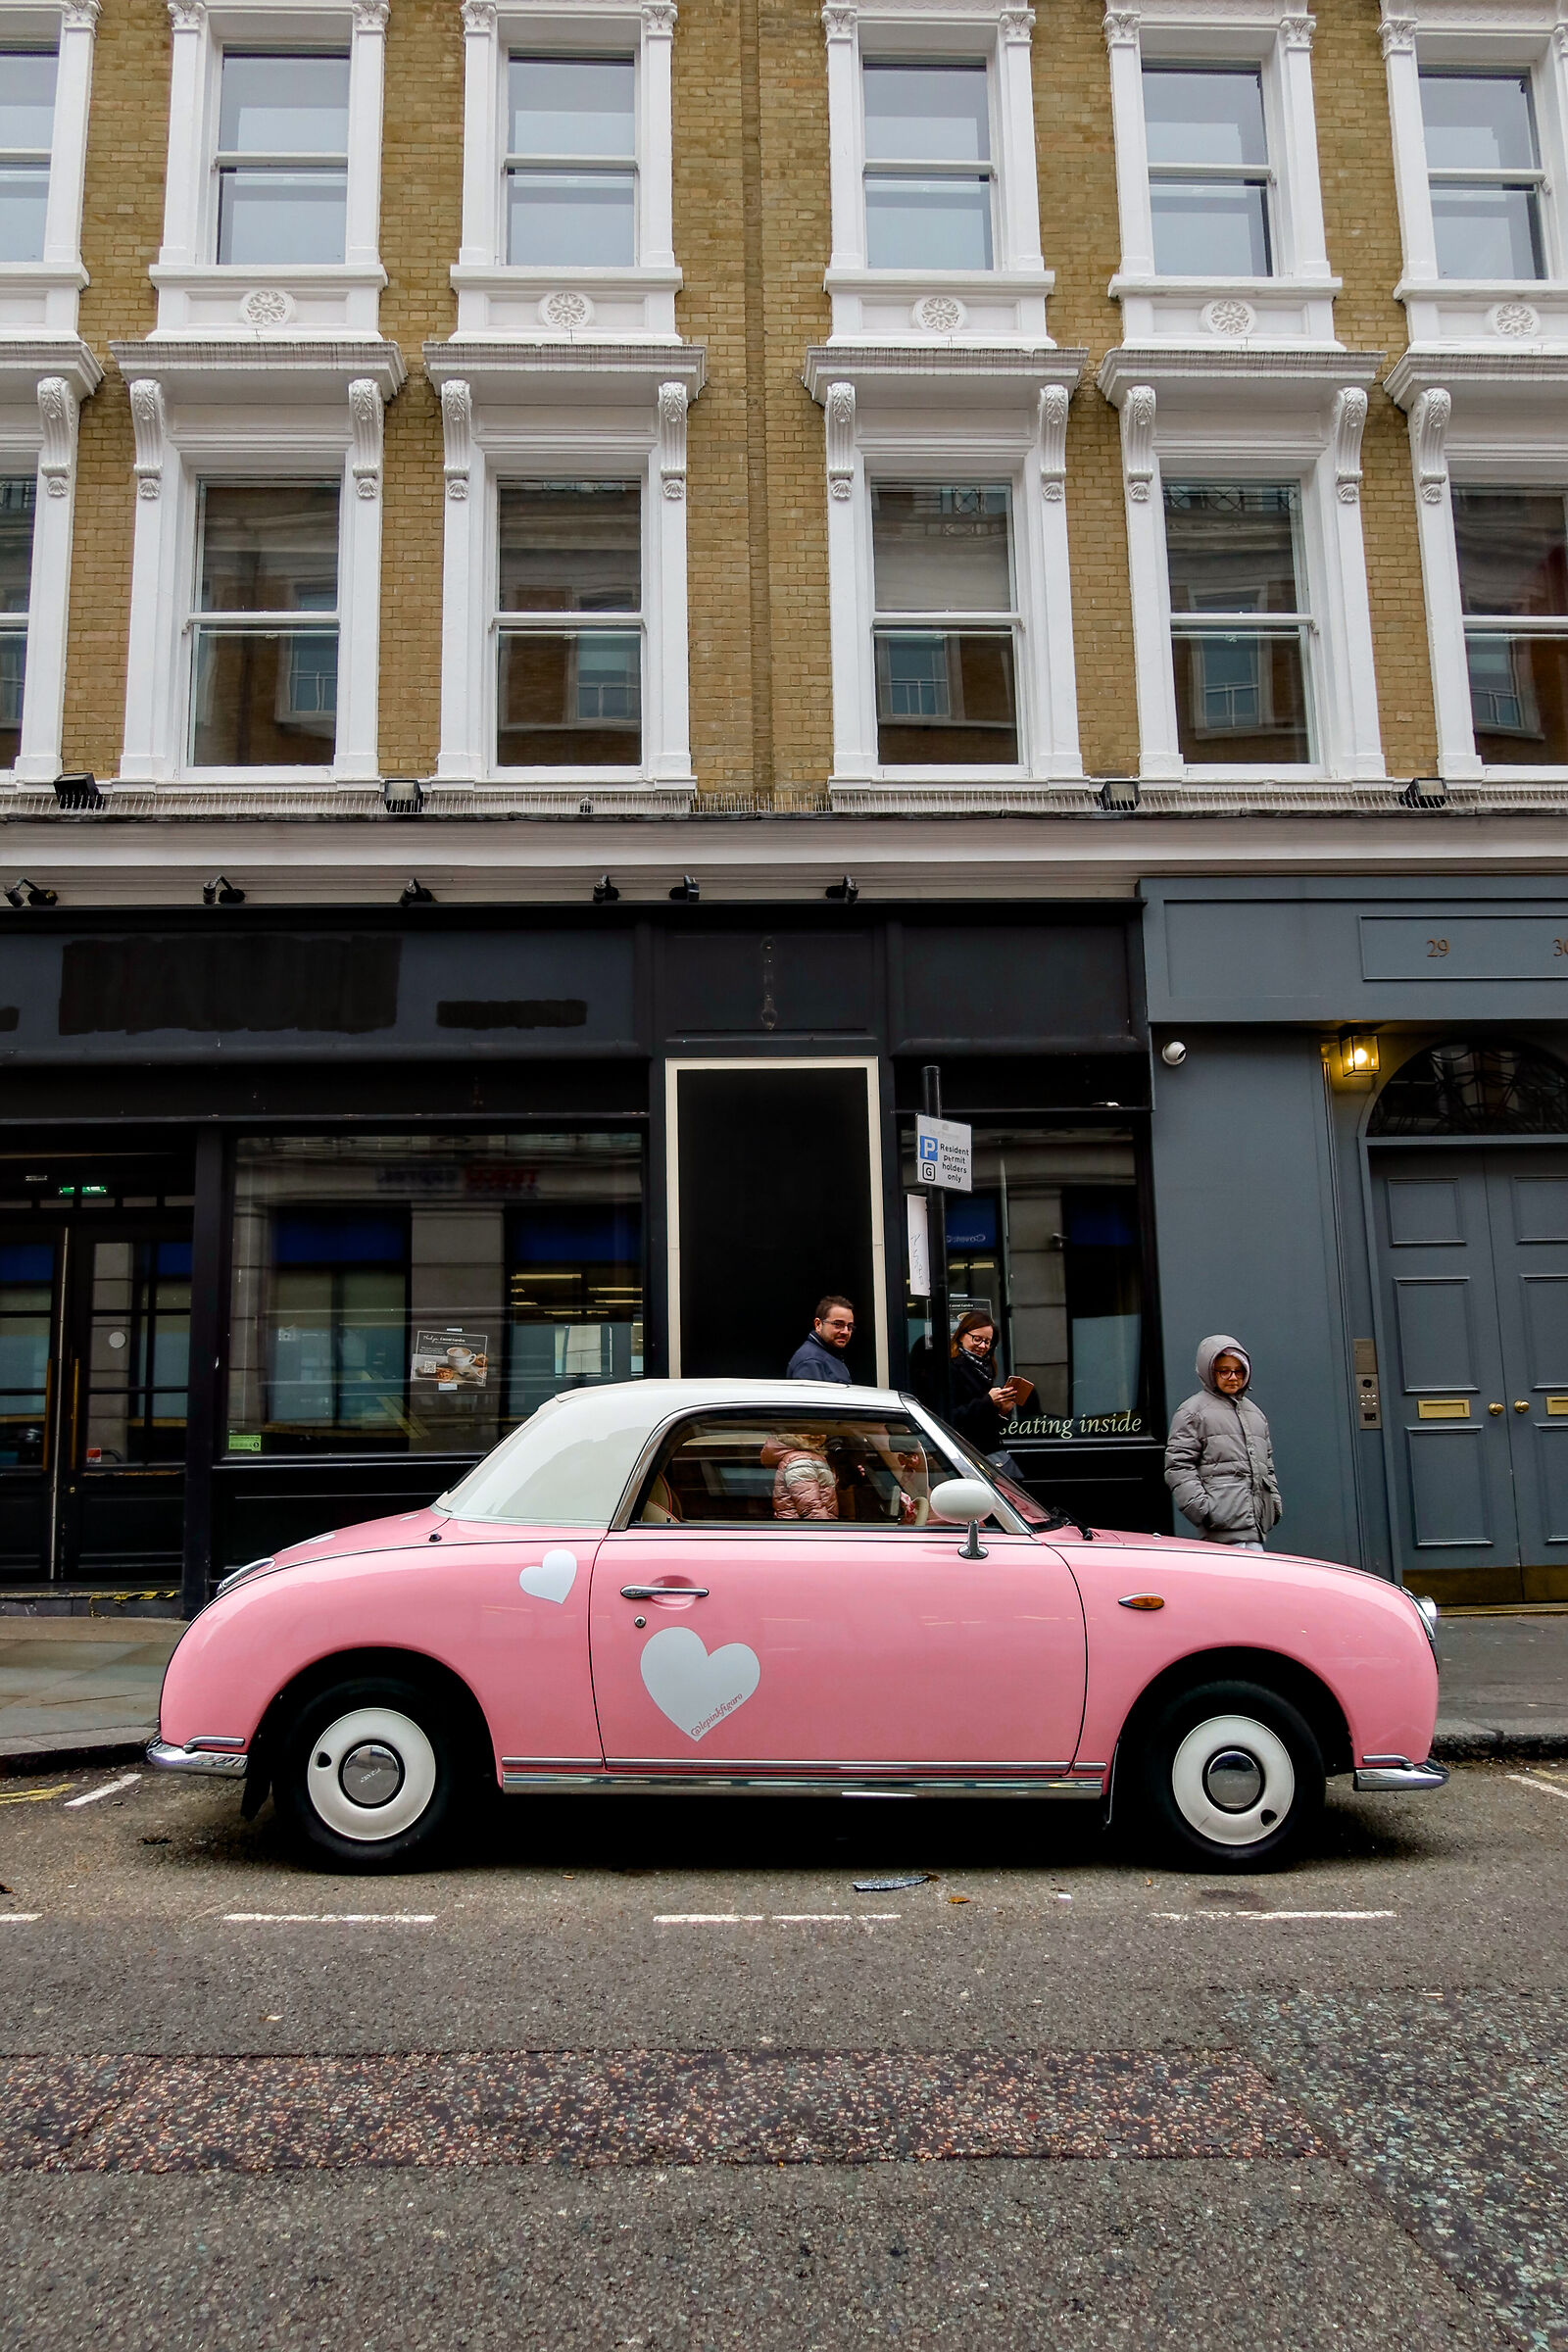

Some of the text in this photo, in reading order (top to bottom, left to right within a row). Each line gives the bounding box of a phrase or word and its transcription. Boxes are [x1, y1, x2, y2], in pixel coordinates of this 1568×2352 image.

[1426, 938, 1450, 957] 29
[940, 1143, 969, 1156] Resident
[943, 1154, 965, 1164] permit
[942, 1162, 967, 1174] holders
[947, 1173, 962, 1183] only
[1079, 1409, 1143, 1434] inside
[690, 1692, 743, 1737] @lepinkfigaro
